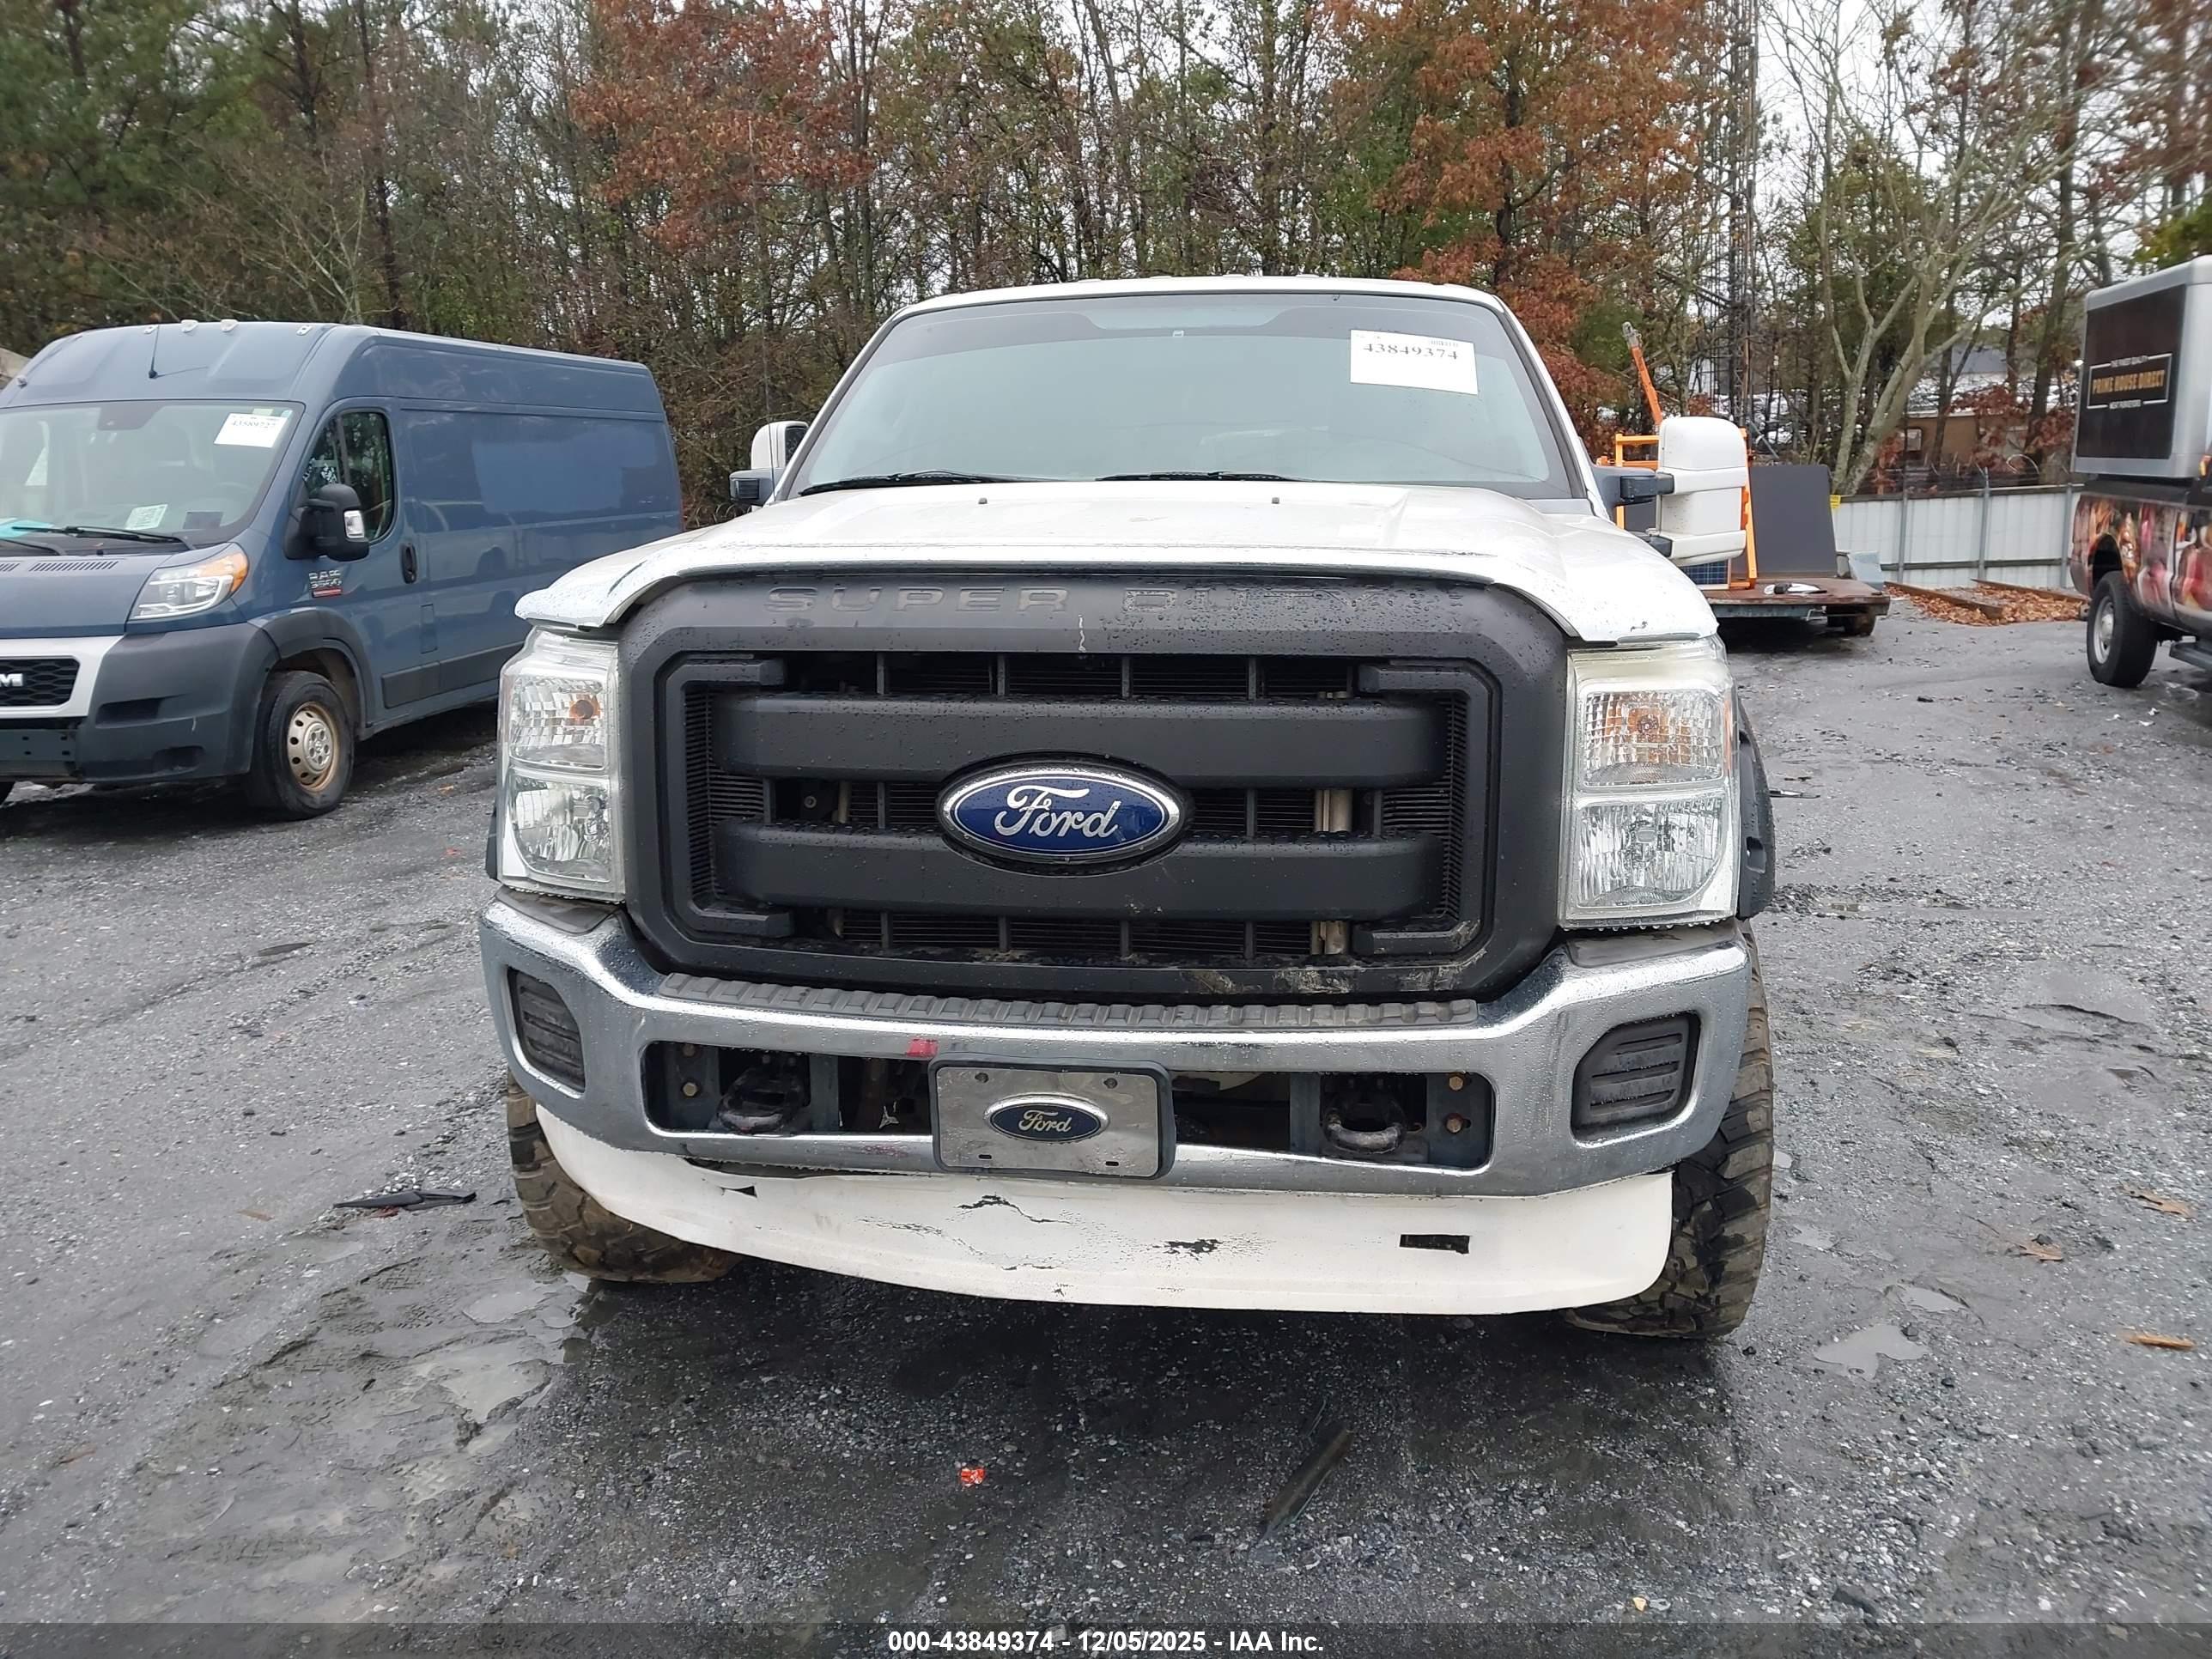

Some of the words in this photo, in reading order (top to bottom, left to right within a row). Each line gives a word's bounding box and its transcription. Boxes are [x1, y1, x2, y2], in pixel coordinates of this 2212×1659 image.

[1363, 343, 1459, 361] 43849374
[2092, 376, 2114, 395] PRIME
[2114, 373, 2138, 392] HOUSE
[2138, 369, 2166, 389] DIRECT
[766, 586, 1070, 612] SUPER
[994, 785, 1122, 838] Ford
[1018, 1109, 1073, 1133] Ford
